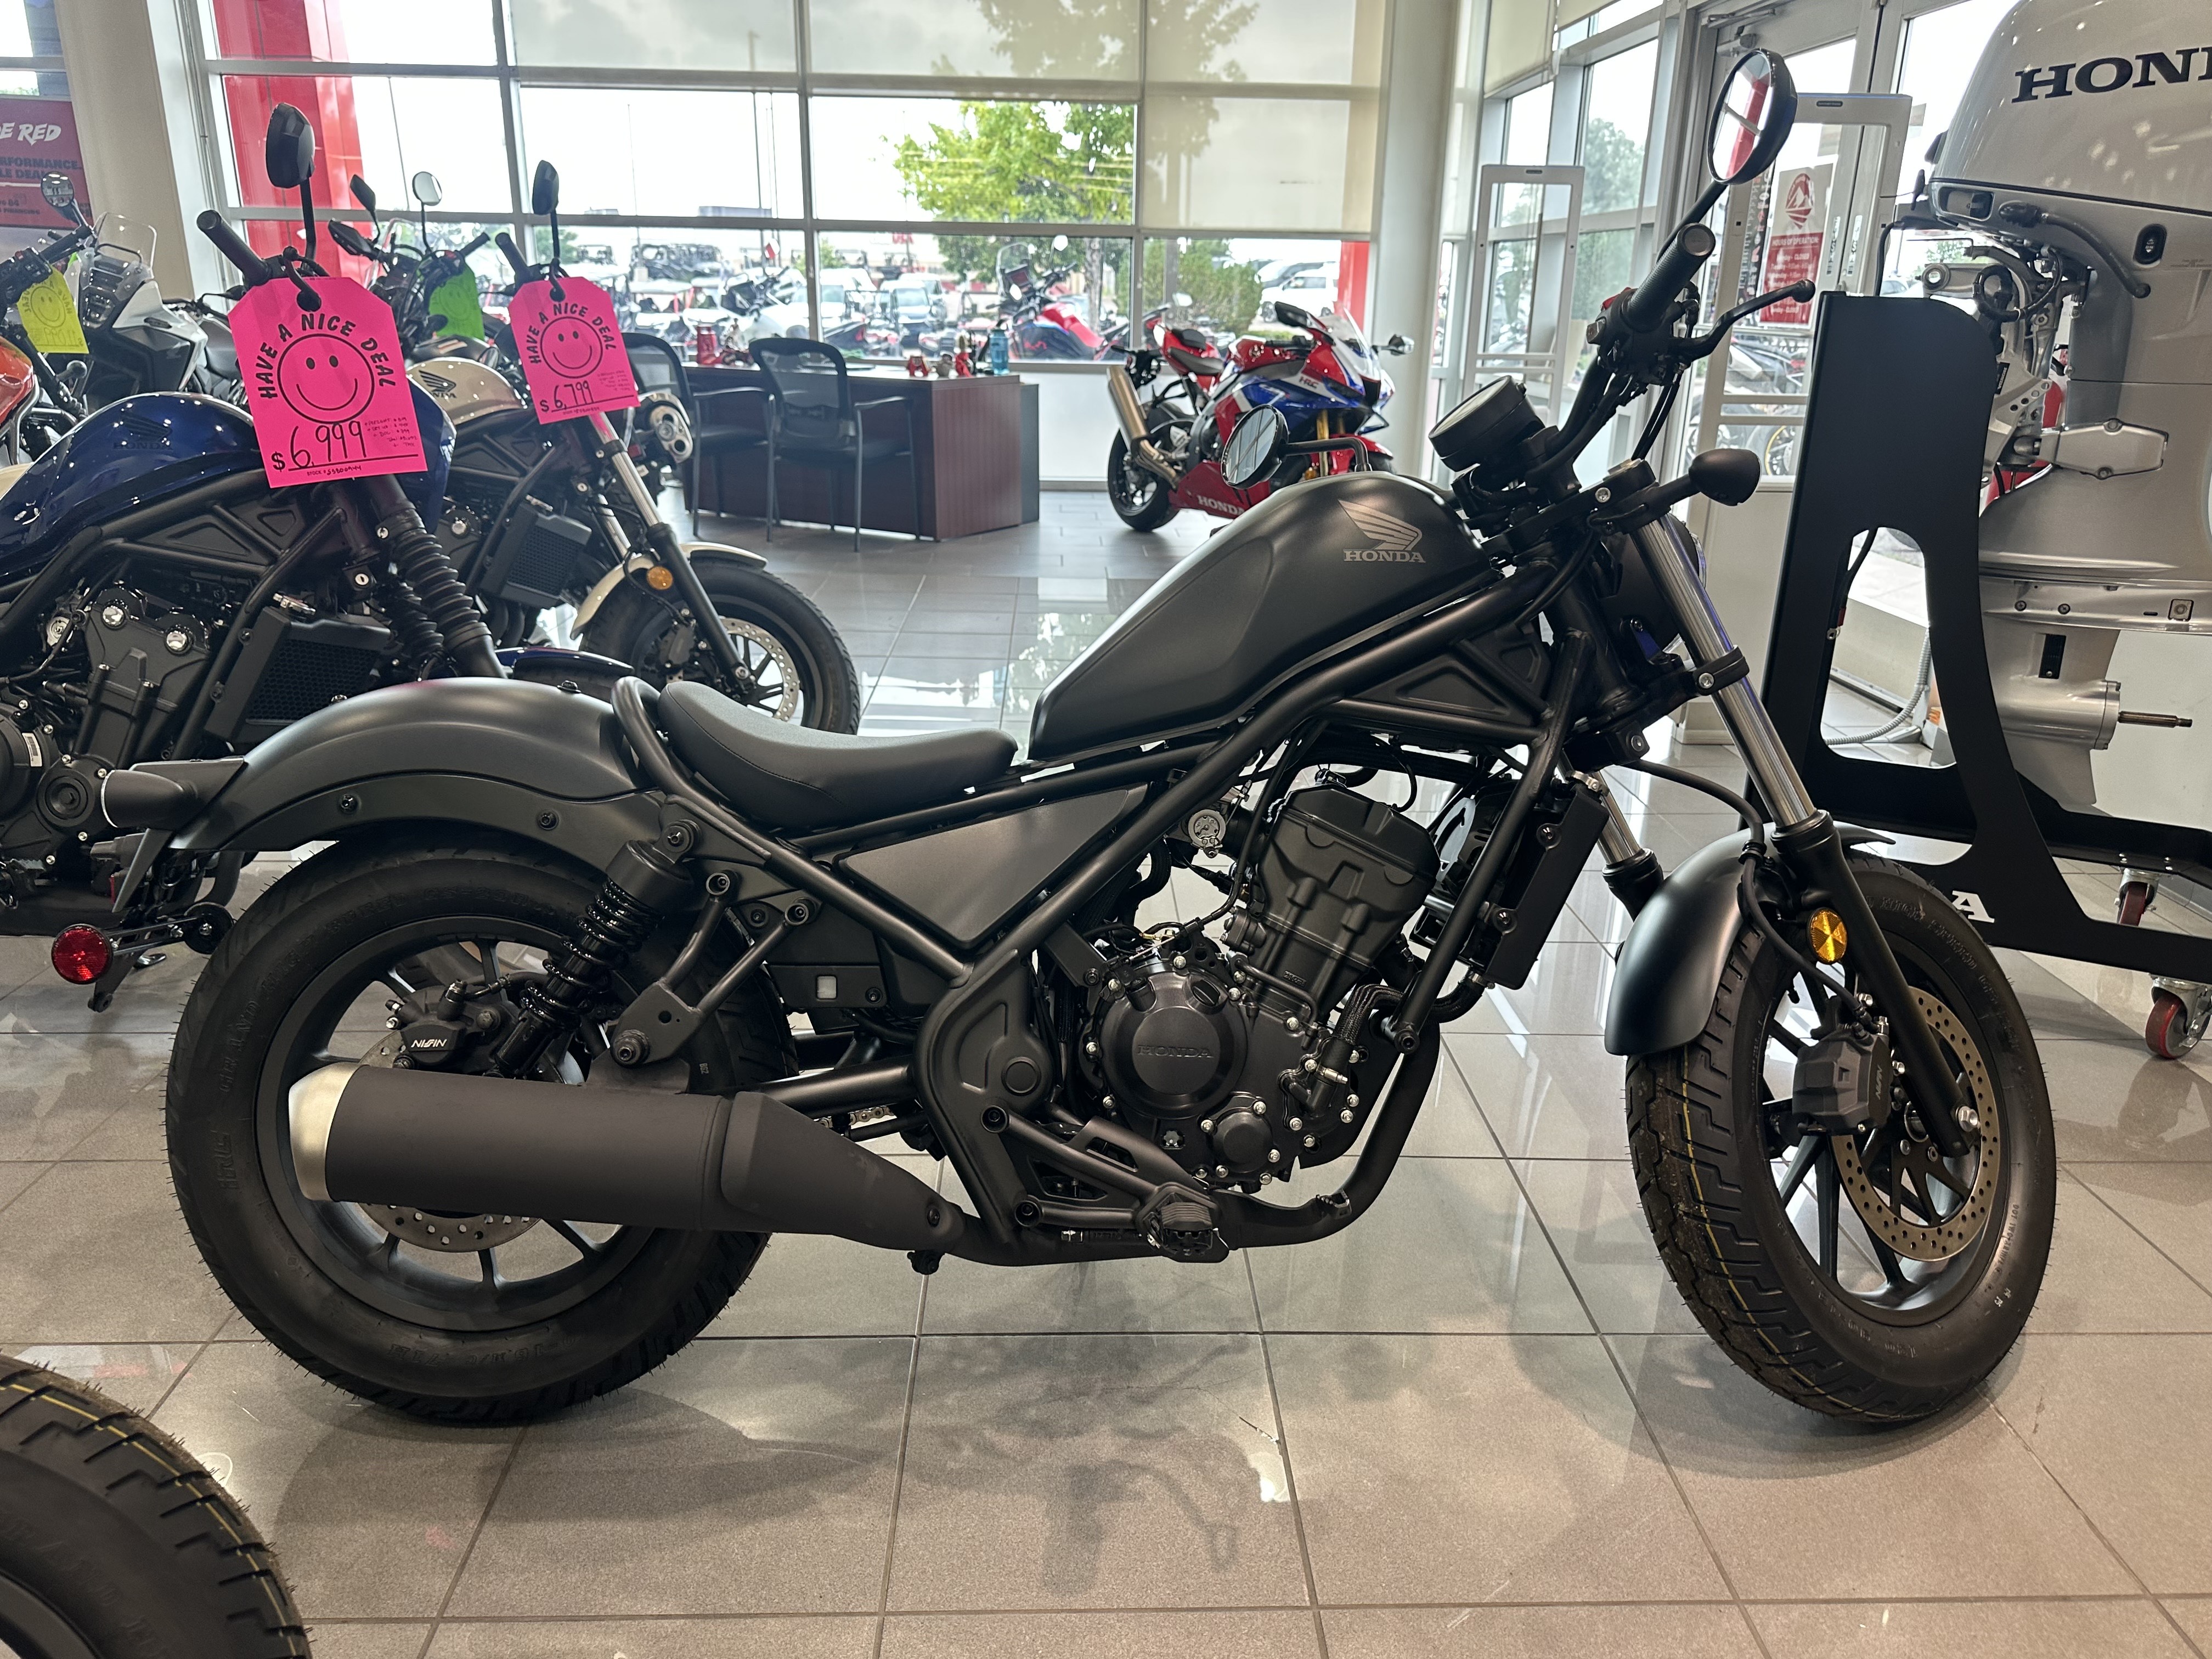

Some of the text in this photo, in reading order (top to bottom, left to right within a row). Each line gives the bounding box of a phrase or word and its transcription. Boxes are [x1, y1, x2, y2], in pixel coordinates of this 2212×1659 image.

[2011, 46, 2212, 104] HON
[18, 123, 61, 146] RED
[527, 303, 617, 364] HAVE A NICE DEAL
[256, 313, 396, 399] HAVE A NICE DEAL
[1299, 376, 1319, 388] HRC
[1344, 550, 1426, 563] HONDA
[1137, 1044, 1214, 1058] HONDA
